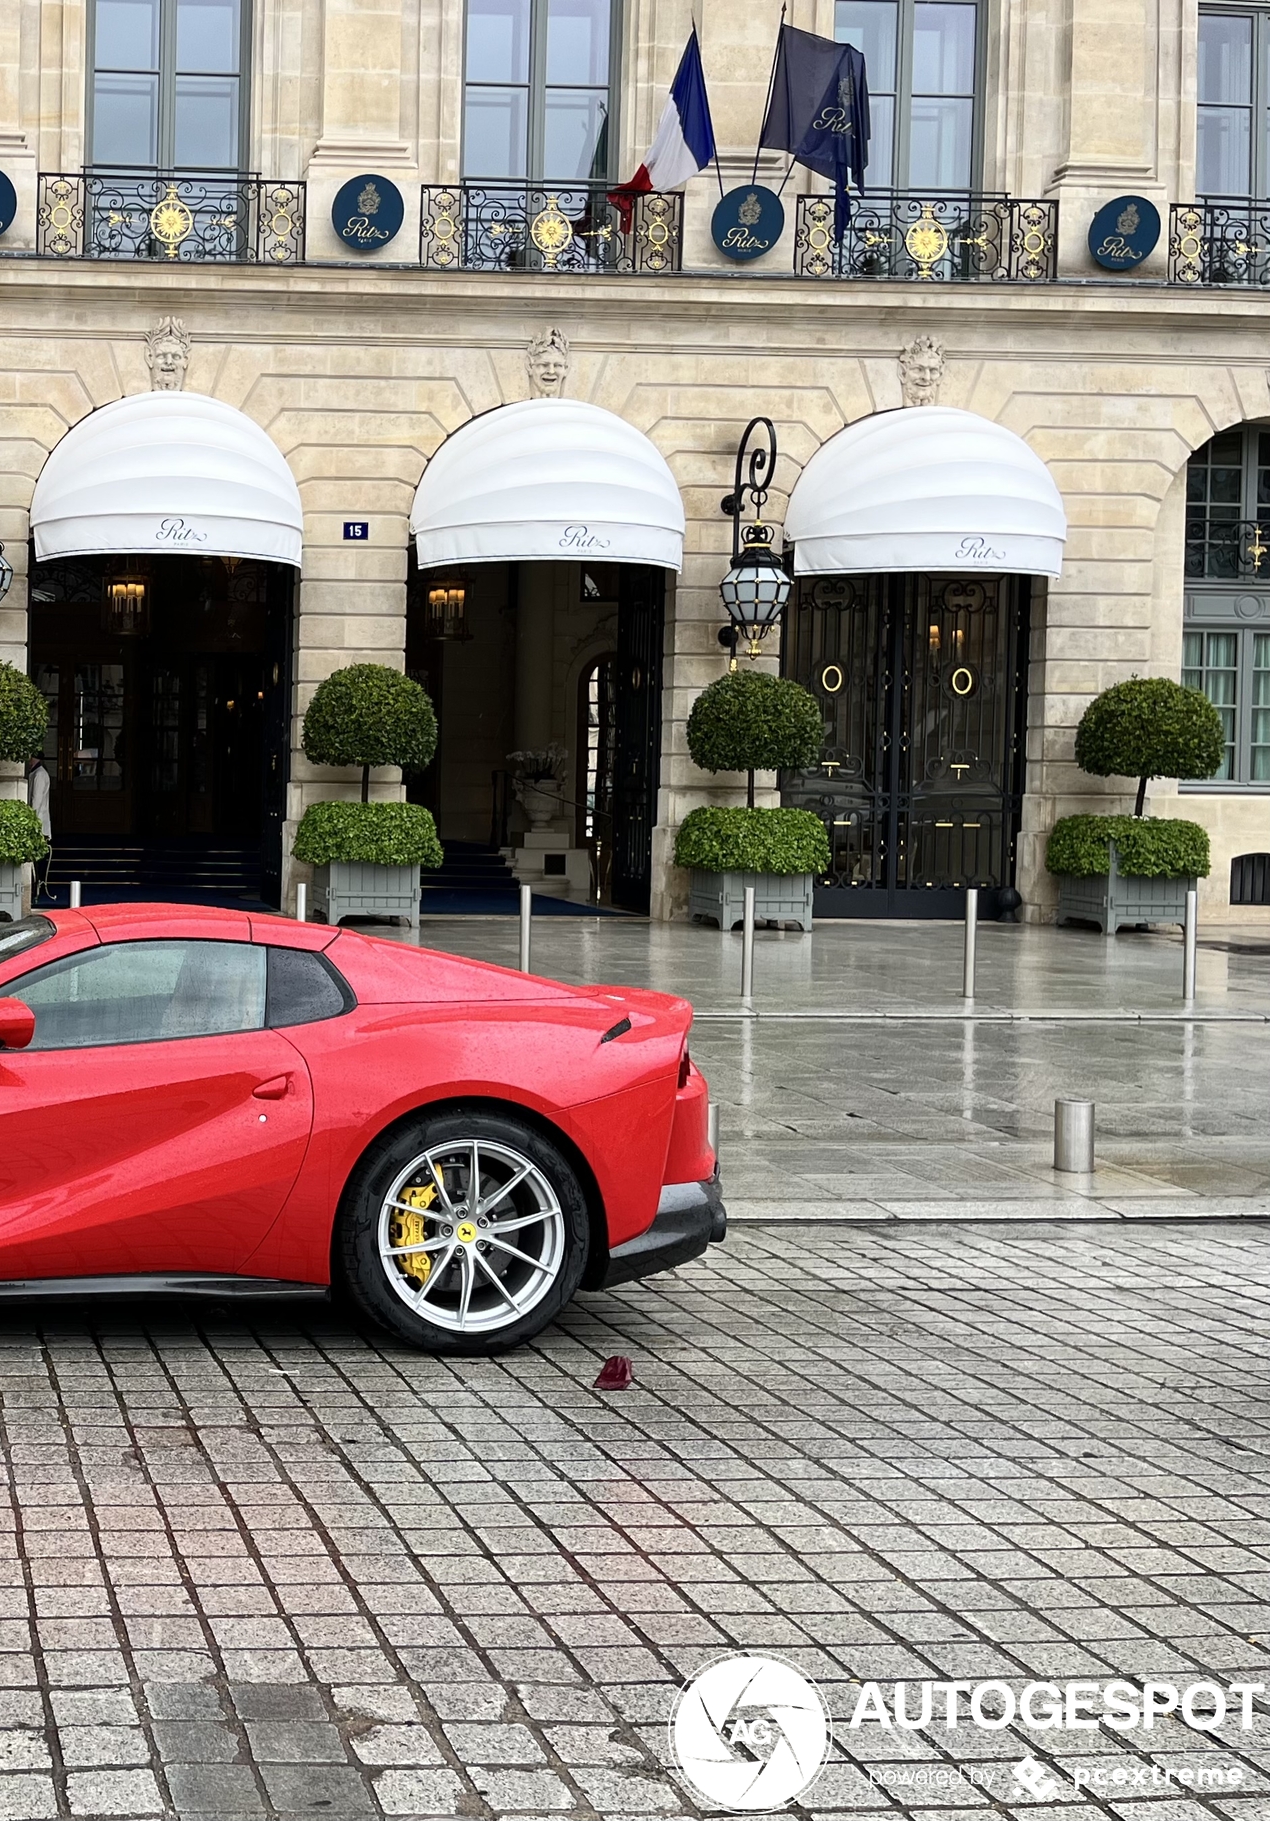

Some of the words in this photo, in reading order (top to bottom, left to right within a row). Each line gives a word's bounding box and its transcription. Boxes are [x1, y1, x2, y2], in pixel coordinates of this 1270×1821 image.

[342, 216, 389, 240] Ritz
[722, 227, 769, 249] Ritz
[1096, 236, 1142, 259] Ritz
[155, 518, 208, 542] Ritz
[349, 525, 362, 537] 15
[558, 525, 611, 548] Ritz
[955, 536, 1006, 559] Ritz
